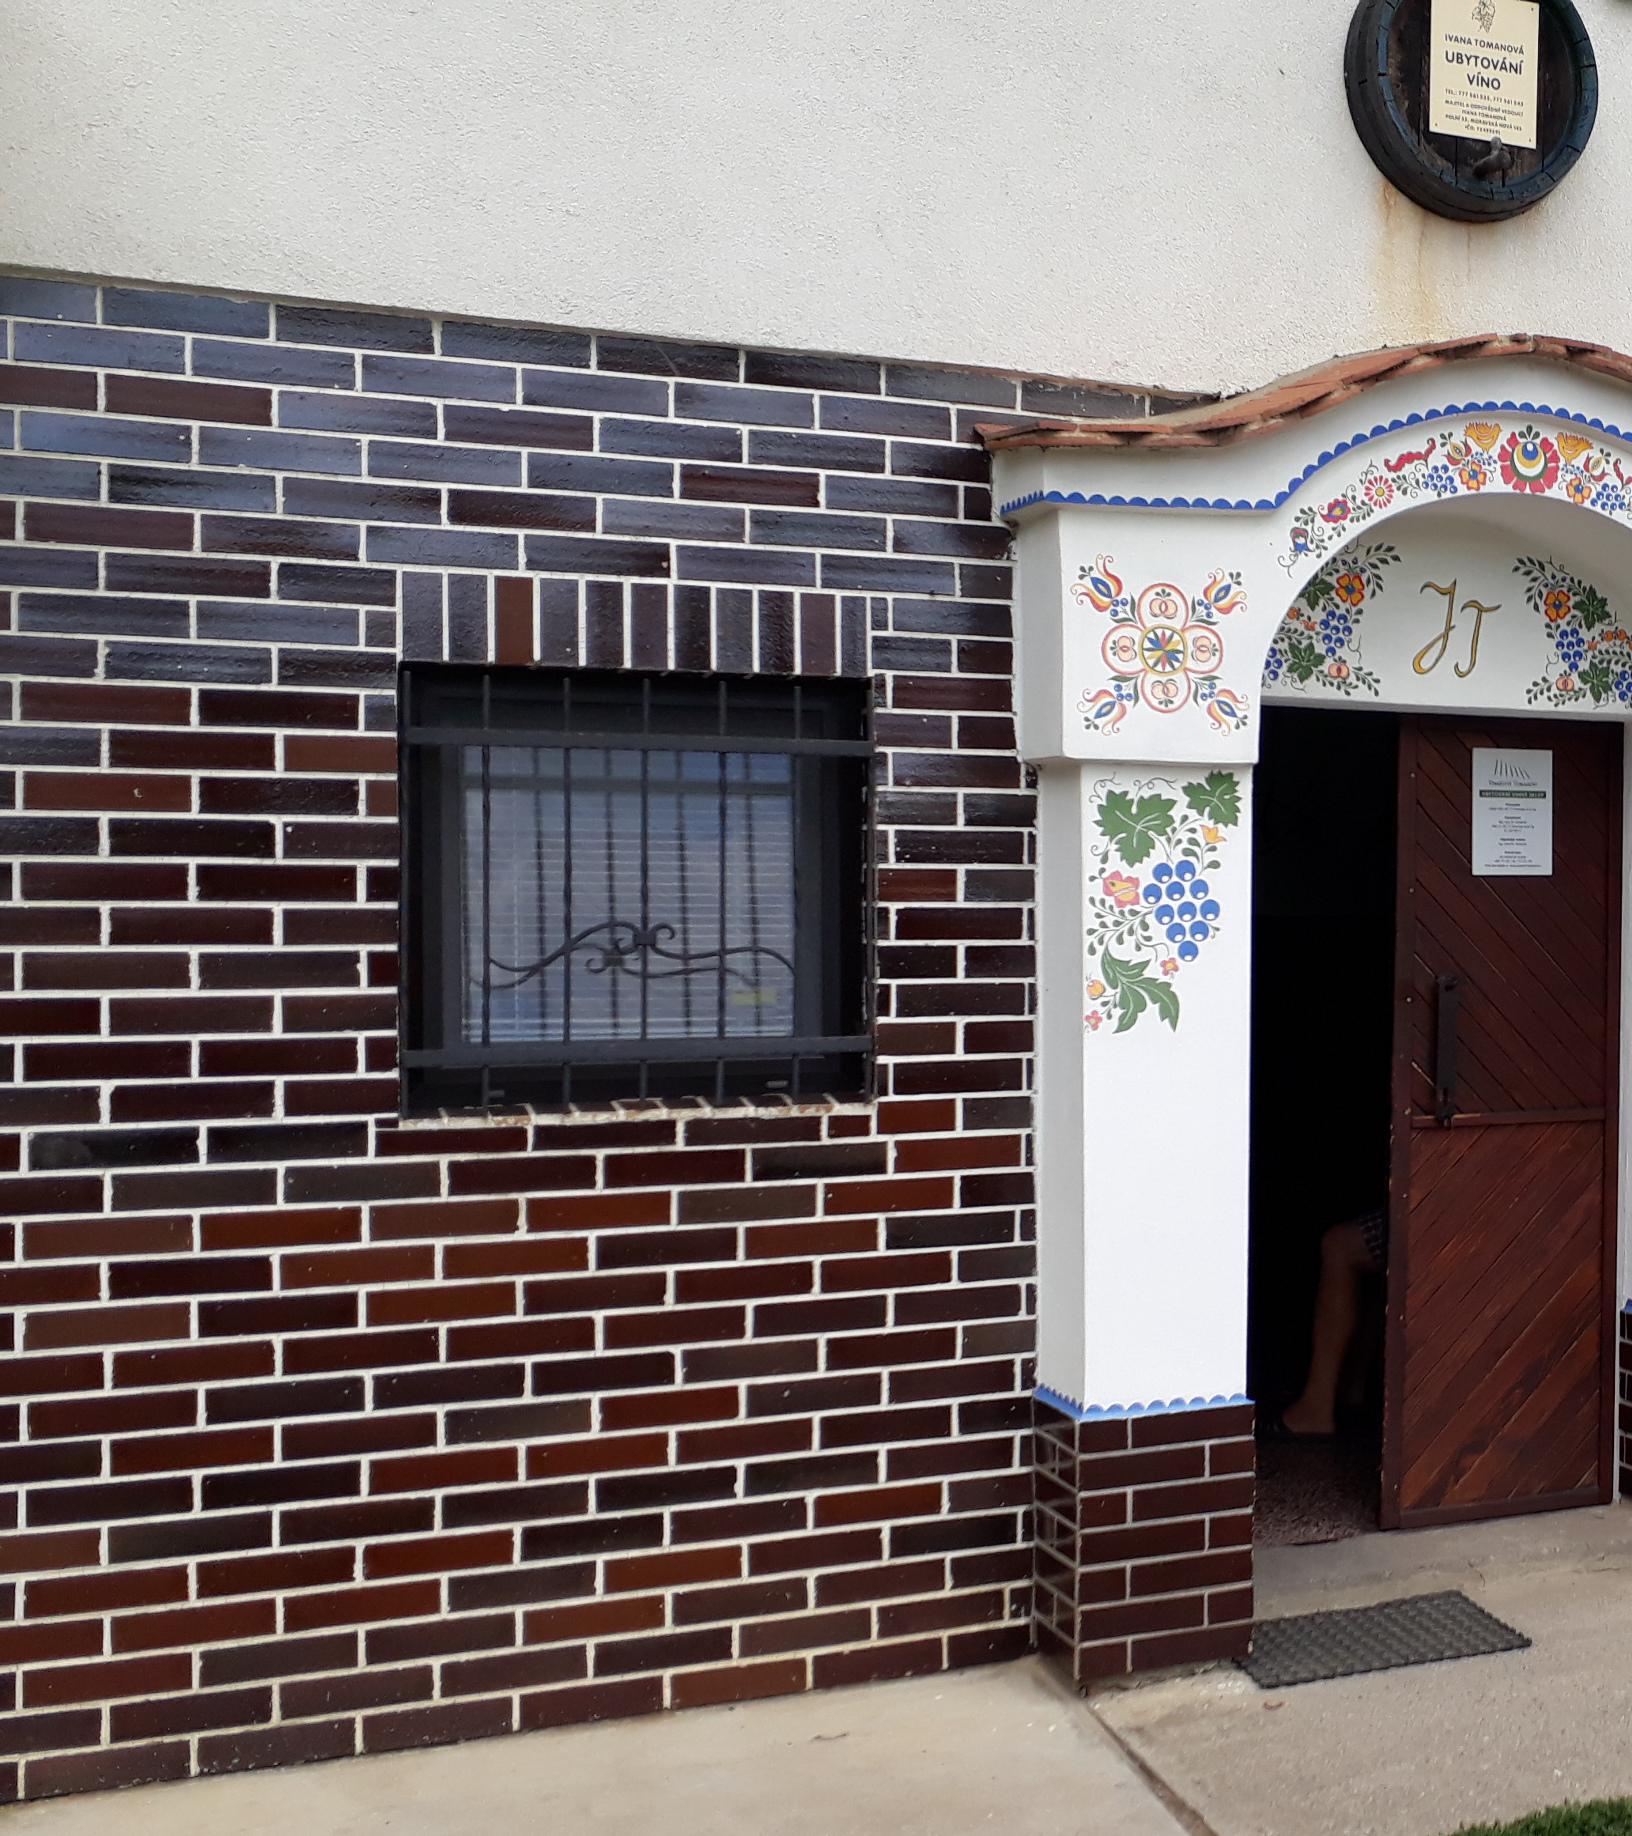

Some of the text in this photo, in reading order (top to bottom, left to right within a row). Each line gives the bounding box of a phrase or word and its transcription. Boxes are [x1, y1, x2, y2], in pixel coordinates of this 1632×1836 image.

[1445, 34, 1524, 55] IVANA TOMANOVÁ
[1445, 50, 1523, 75] UBYTOVÁNÍ
[1467, 72, 1501, 90] VÍNO
